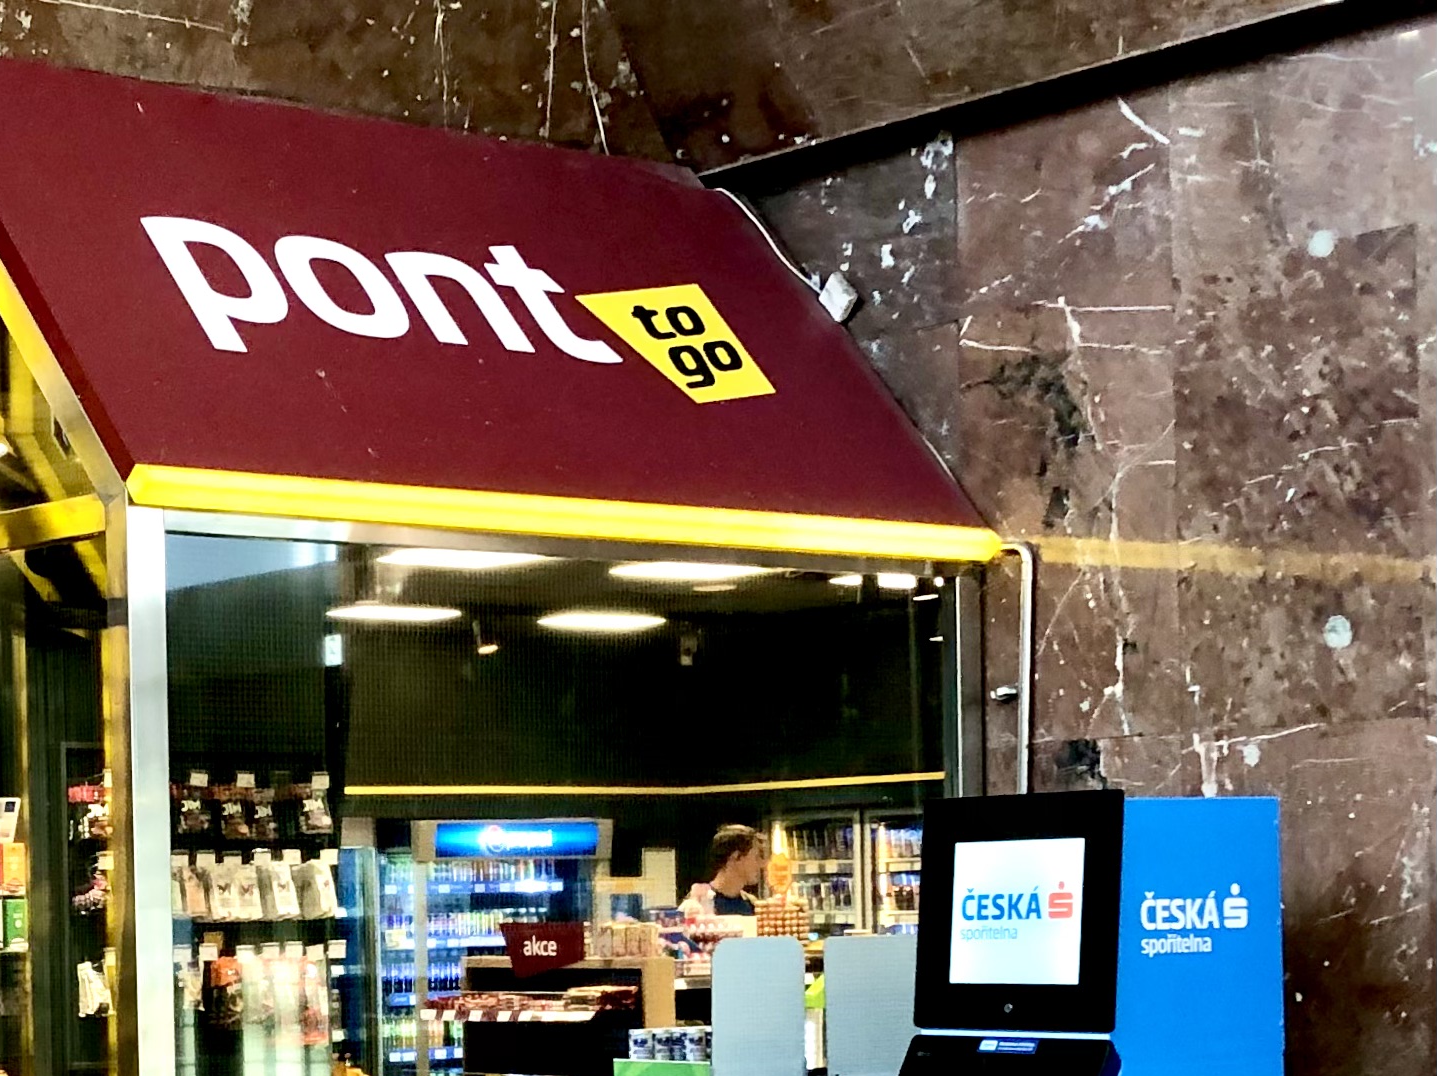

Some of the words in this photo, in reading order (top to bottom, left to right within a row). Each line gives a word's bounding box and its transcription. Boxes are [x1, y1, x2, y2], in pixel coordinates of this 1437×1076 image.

[140, 216, 623, 363] pont
[631, 303, 706, 339] to
[668, 340, 743, 389] go
[961, 886, 1042, 920] ČESKÁ
[1140, 890, 1220, 930] ČESKÁ
[523, 935, 557, 956] akce
[960, 926, 1018, 941] spořitelna
[1140, 933, 1212, 957] spořitelna
